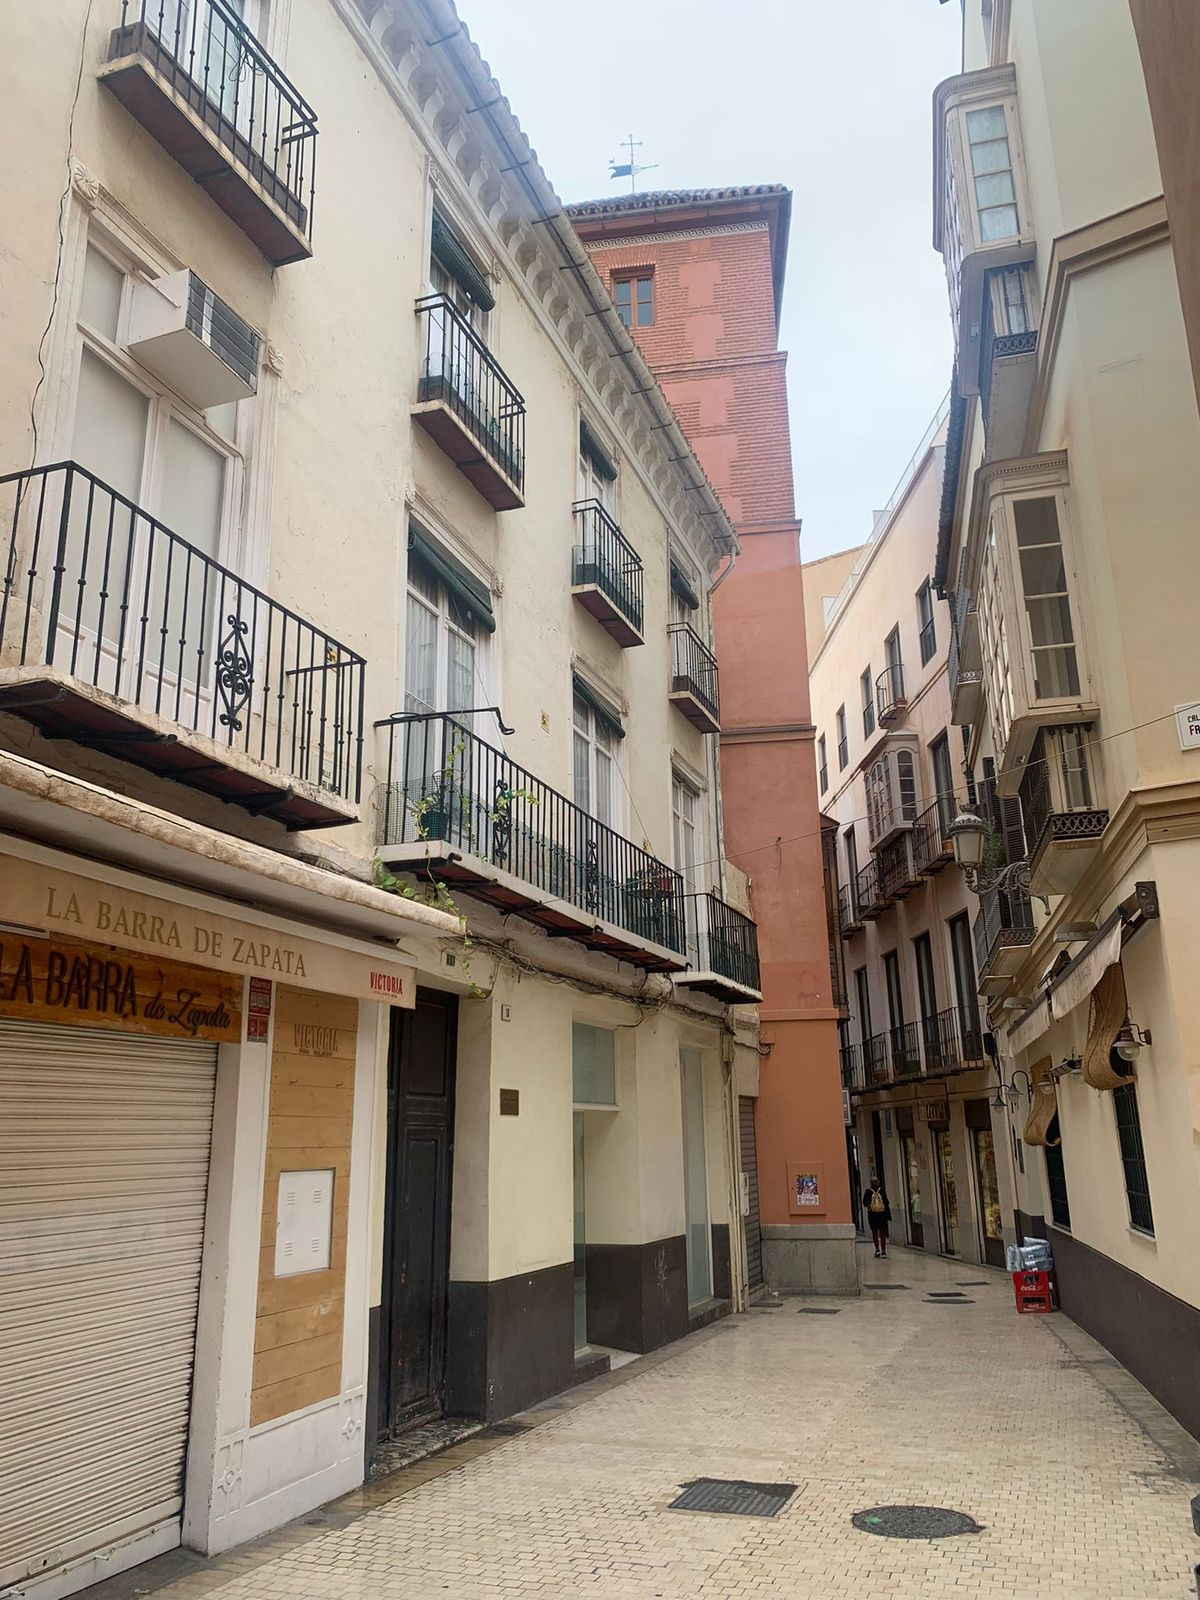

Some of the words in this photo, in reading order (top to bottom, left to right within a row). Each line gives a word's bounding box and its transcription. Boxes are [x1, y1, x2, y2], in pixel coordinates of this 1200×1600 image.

[47, 887, 83, 925] LA
[97, 900, 182, 948] BARRA
[193, 926, 223, 958] DE
[232, 937, 307, 977] ZAPATA
[46, 950, 137, 1017] BARRA
[144, 990, 165, 1020] de
[168, 988, 231, 1036] Zapata
[370, 971, 403, 995] VICTORIA
